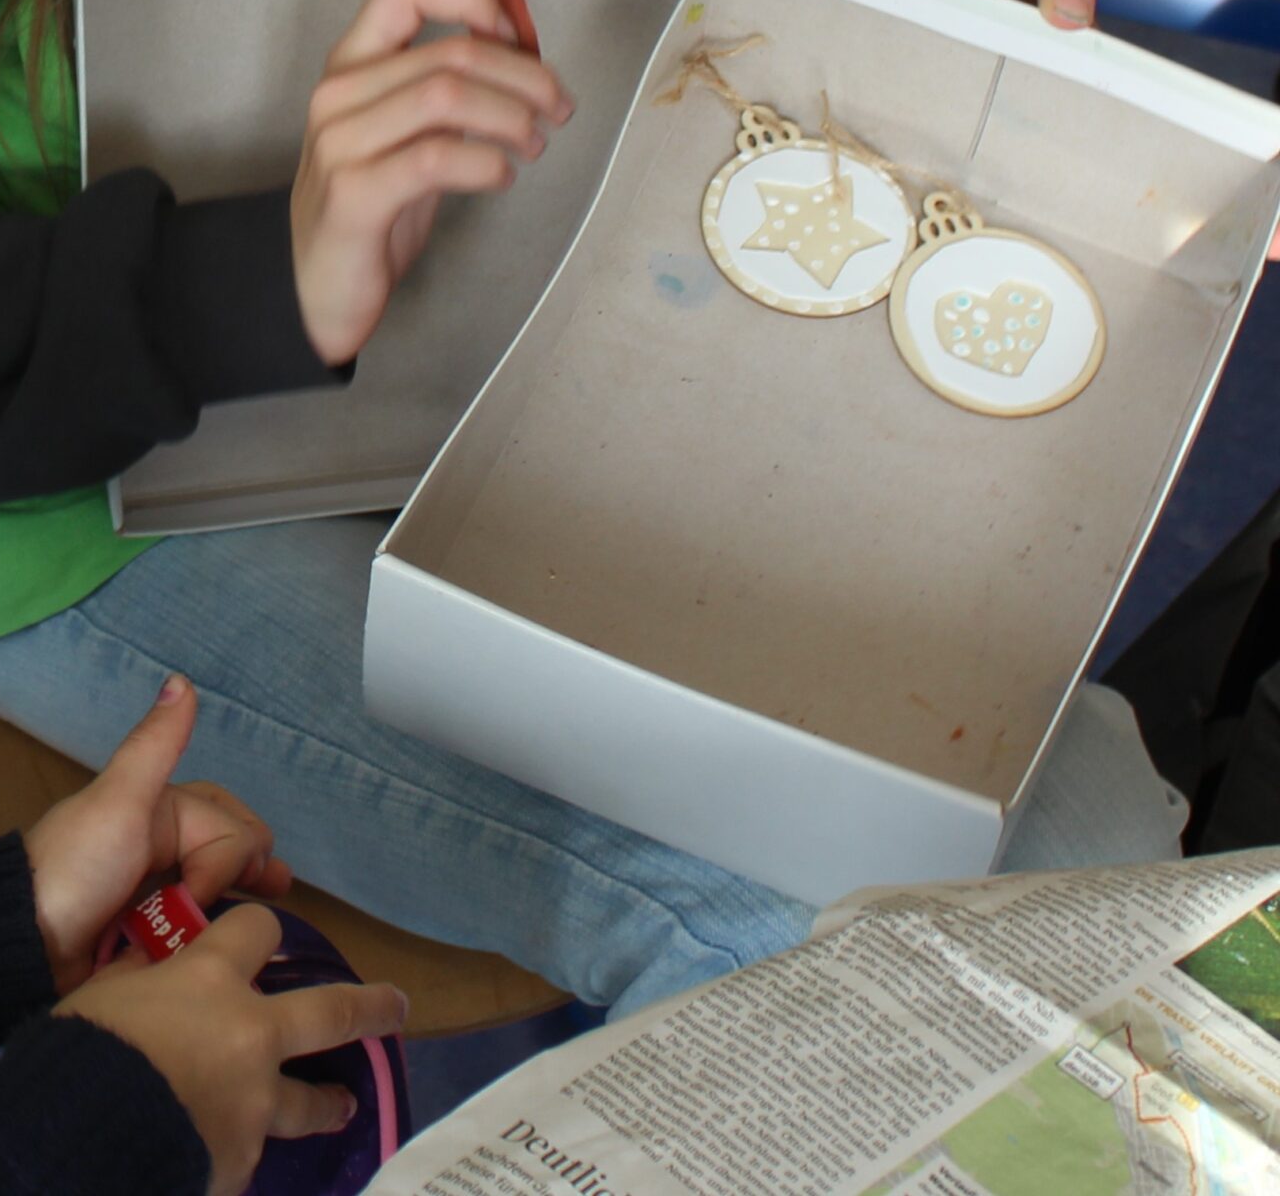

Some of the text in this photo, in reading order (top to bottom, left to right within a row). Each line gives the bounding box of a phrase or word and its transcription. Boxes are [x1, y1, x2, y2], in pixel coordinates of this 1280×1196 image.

[143, 895, 173, 936] Step
[988, 990, 1014, 1010] einer
[1012, 1011, 1049, 1038] knapp
[499, 1119, 630, 1196] Deutlic
